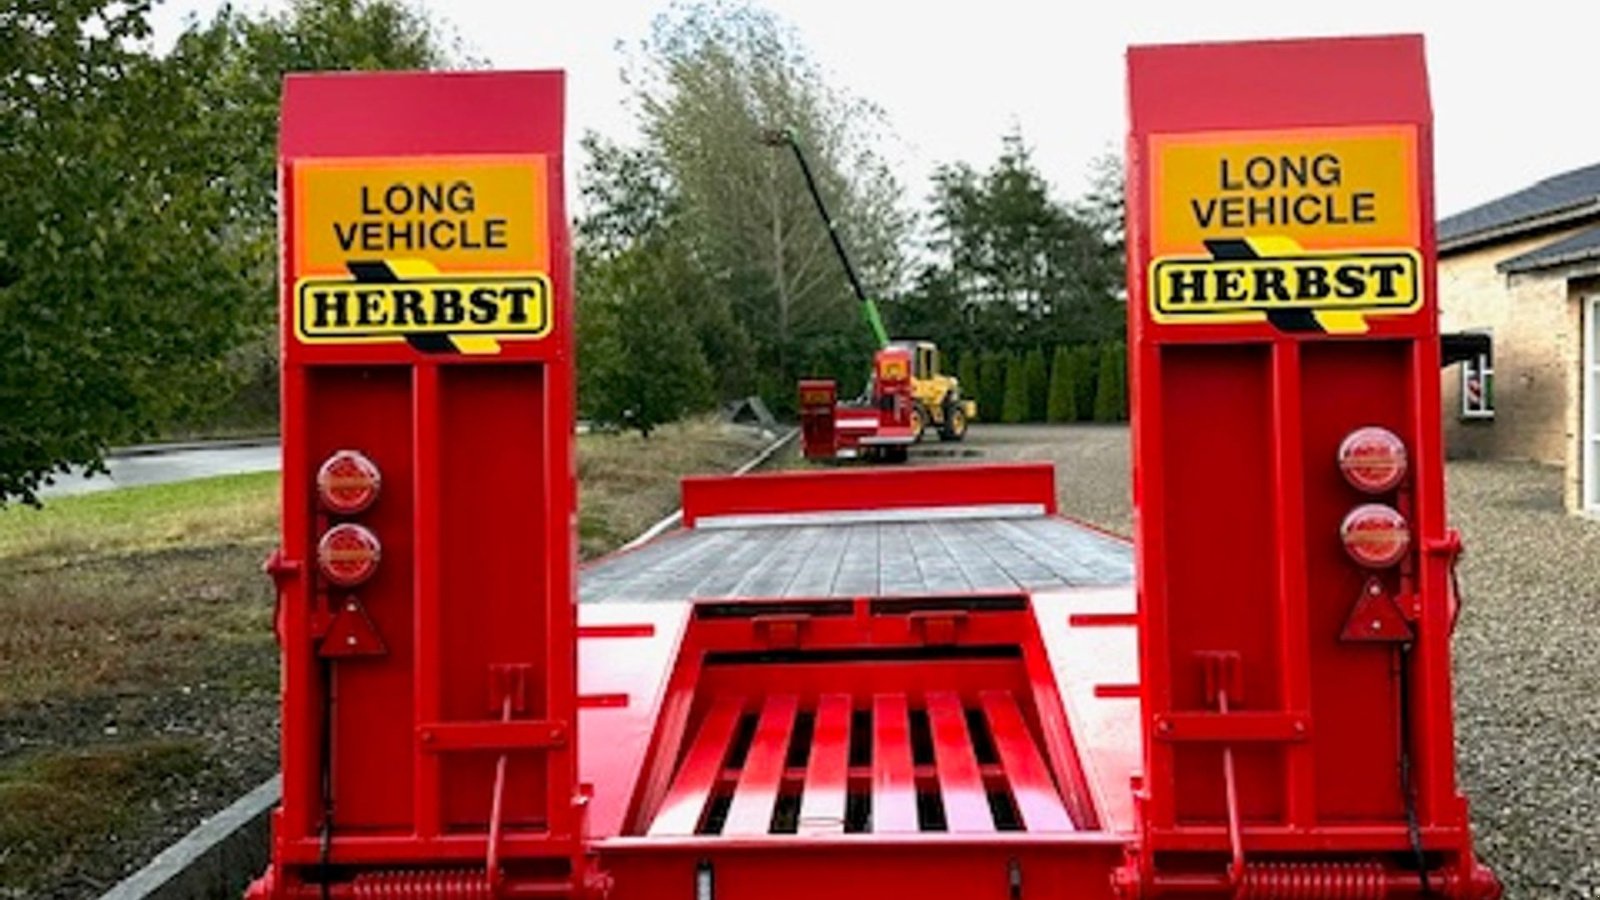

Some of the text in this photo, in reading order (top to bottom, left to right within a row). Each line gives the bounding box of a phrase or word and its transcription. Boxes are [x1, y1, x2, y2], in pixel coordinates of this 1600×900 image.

[1220, 154, 1341, 191] LONG
[361, 181, 476, 215] LONG
[1191, 192, 1376, 228] VEHICLE
[333, 219, 508, 251] VEHICLE
[1168, 264, 1405, 304] HERBST
[312, 288, 535, 328] HERBST
